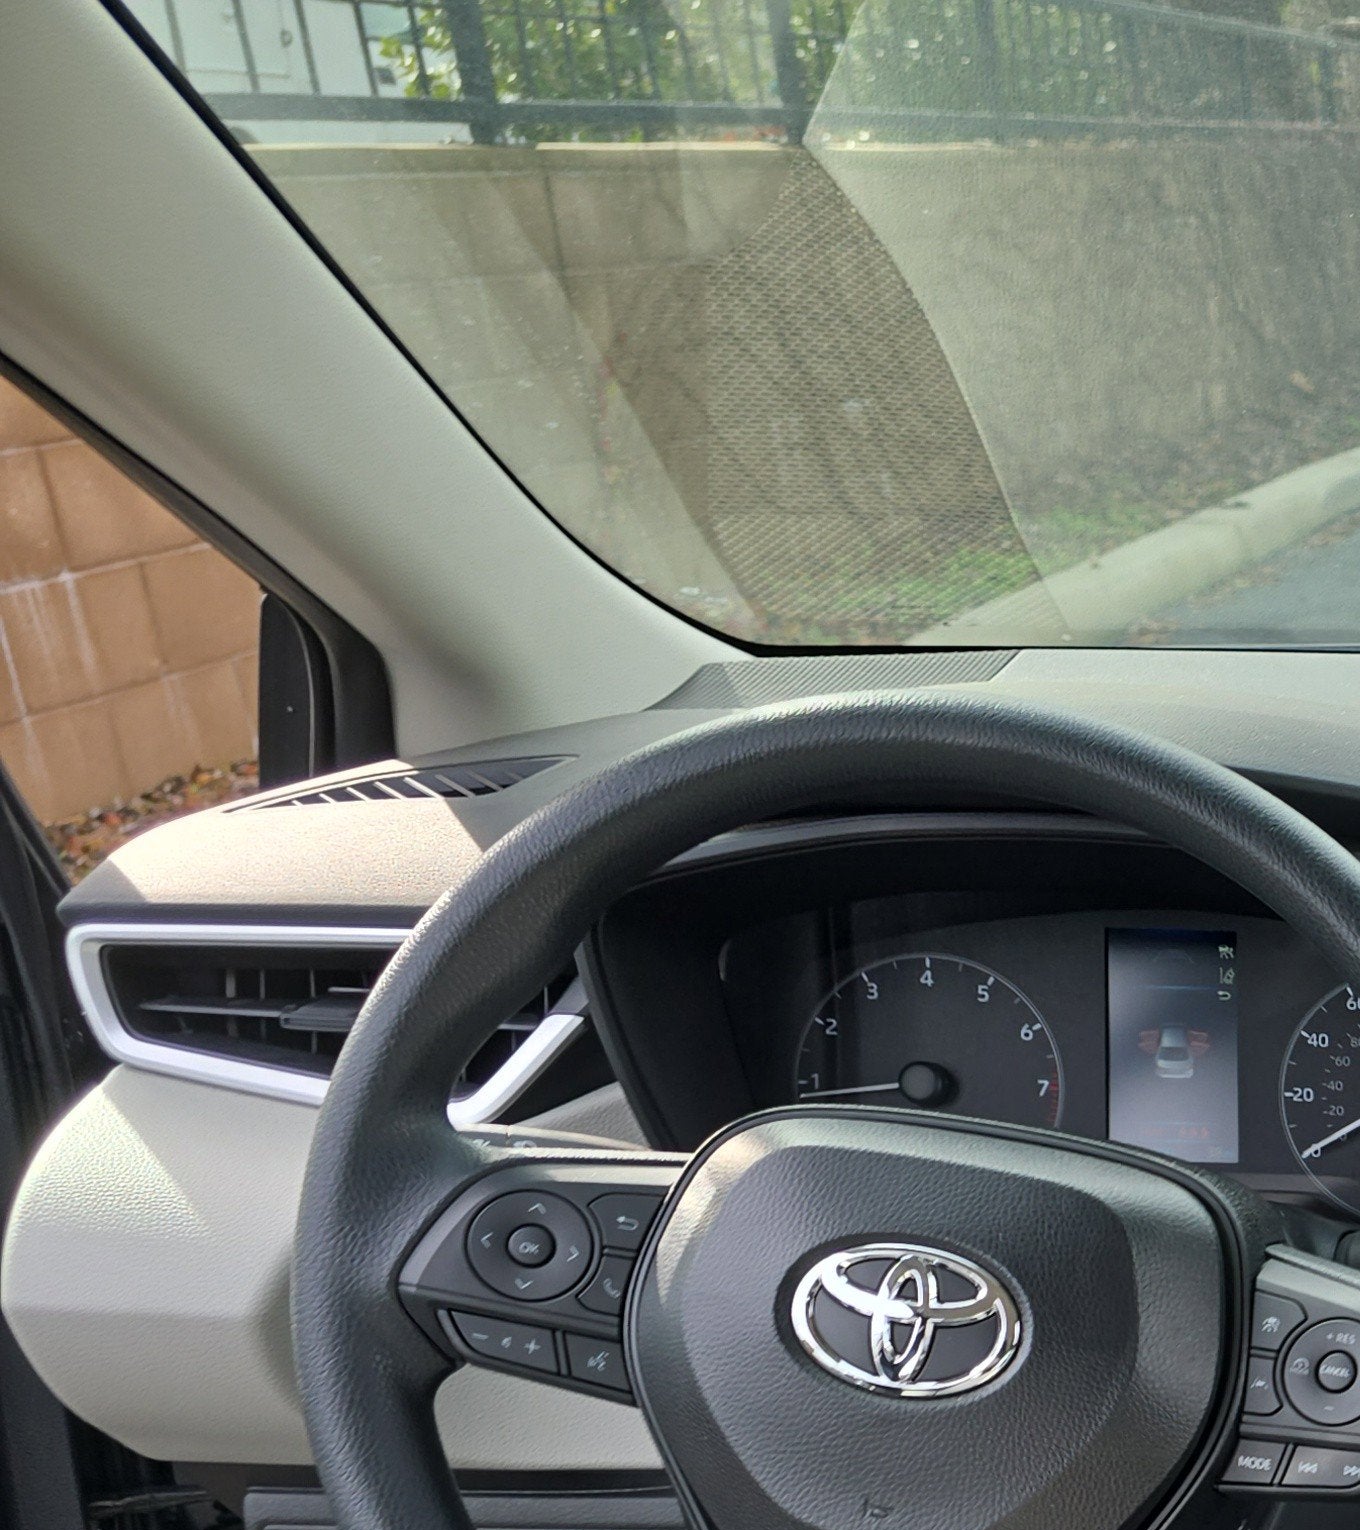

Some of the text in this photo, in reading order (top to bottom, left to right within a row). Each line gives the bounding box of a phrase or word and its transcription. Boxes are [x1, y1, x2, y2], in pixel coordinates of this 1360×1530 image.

[920, 970, 933, 986] 4
[867, 982, 878, 999] 3
[977, 986, 989, 1002] 5
[826, 1019, 837, 1035] 2
[1020, 1025, 1033, 1040] 6
[1308, 1033, 1328, 1047] 40
[1336, 1057, 1350, 1066] 60
[1038, 1079, 1049, 1096] 7
[1328, 1081, 1343, 1091] 40
[1293, 1088, 1314, 1102] 20
[1328, 1106, 1343, 1116] 20
[519, 1242, 539, 1255] OK
[1336, 1333, 1355, 1345] RES
[1238, 1456, 1272, 1471] MODE
